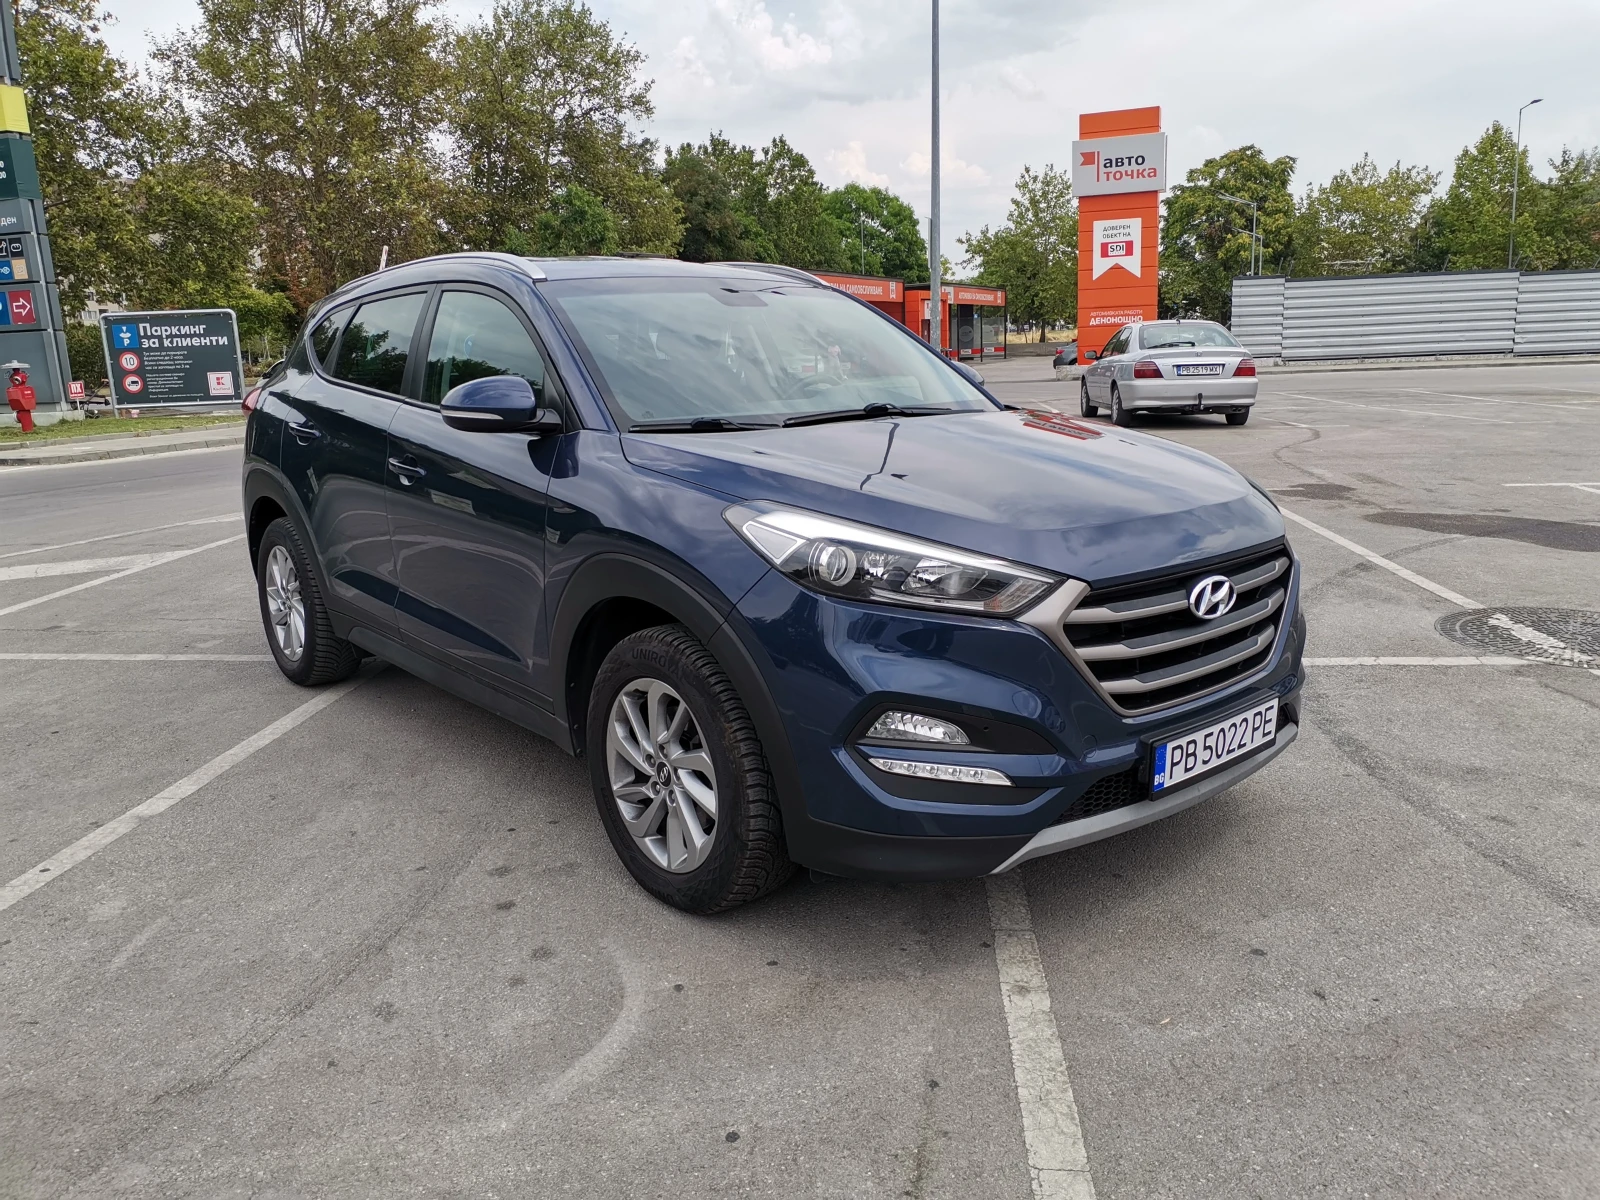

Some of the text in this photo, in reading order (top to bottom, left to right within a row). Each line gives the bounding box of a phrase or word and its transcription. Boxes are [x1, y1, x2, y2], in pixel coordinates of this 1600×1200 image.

[1103, 155, 1145, 169] авто
[1103, 167, 1157, 181] точка
[0, 216, 17, 227] ден
[1102, 224, 1131, 232] ДОВЕРЕН
[1109, 244, 1125, 253] SDI
[1089, 315, 1143, 326] ДЕНОНОЩНО
[138, 323, 207, 338] Паркинг
[141, 336, 228, 348] за клиенти
[124, 357, 136, 367] 10
[1181, 365, 1218, 373] PB 2519 MX
[1169, 704, 1274, 780] PB 5022 PE
[1154, 772, 1165, 786] BG
